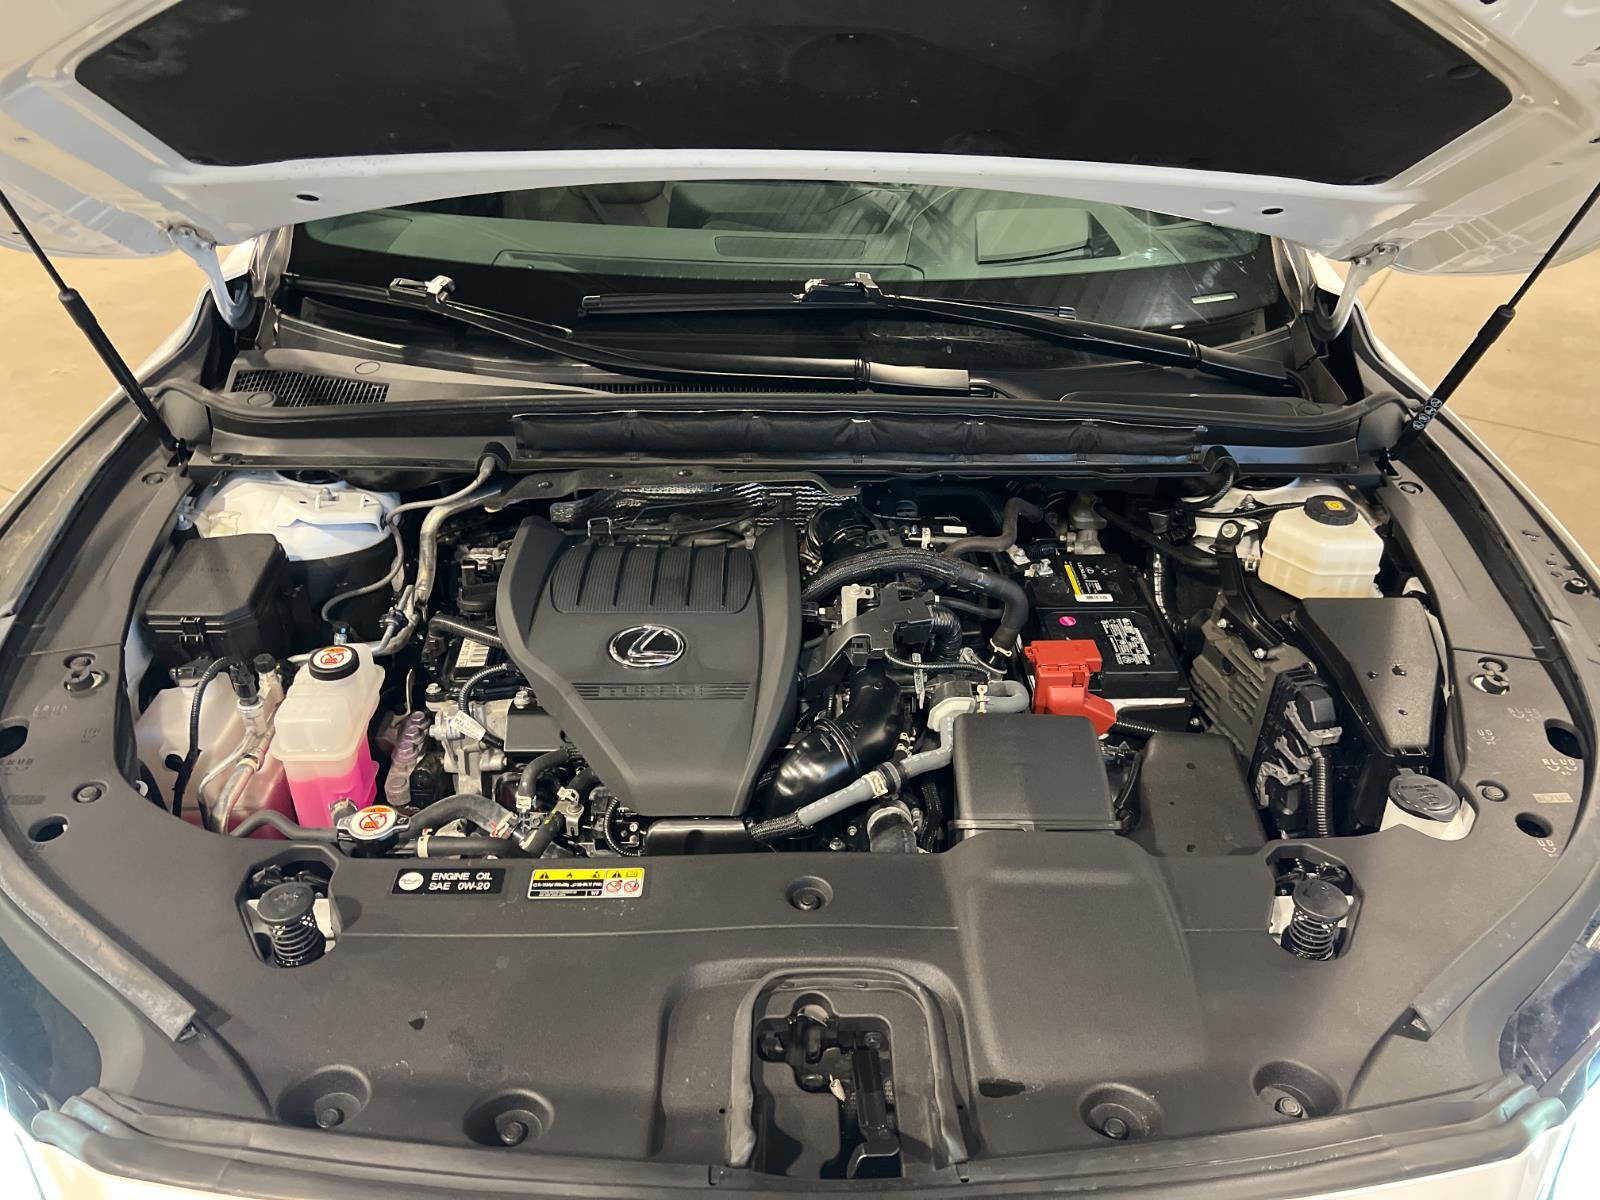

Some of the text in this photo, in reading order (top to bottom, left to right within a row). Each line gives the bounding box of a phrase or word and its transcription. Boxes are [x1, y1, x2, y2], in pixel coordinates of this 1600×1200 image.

[431, 872, 492, 881] ENGINE OIL
[429, 882, 490, 890] SAE 0W-20
